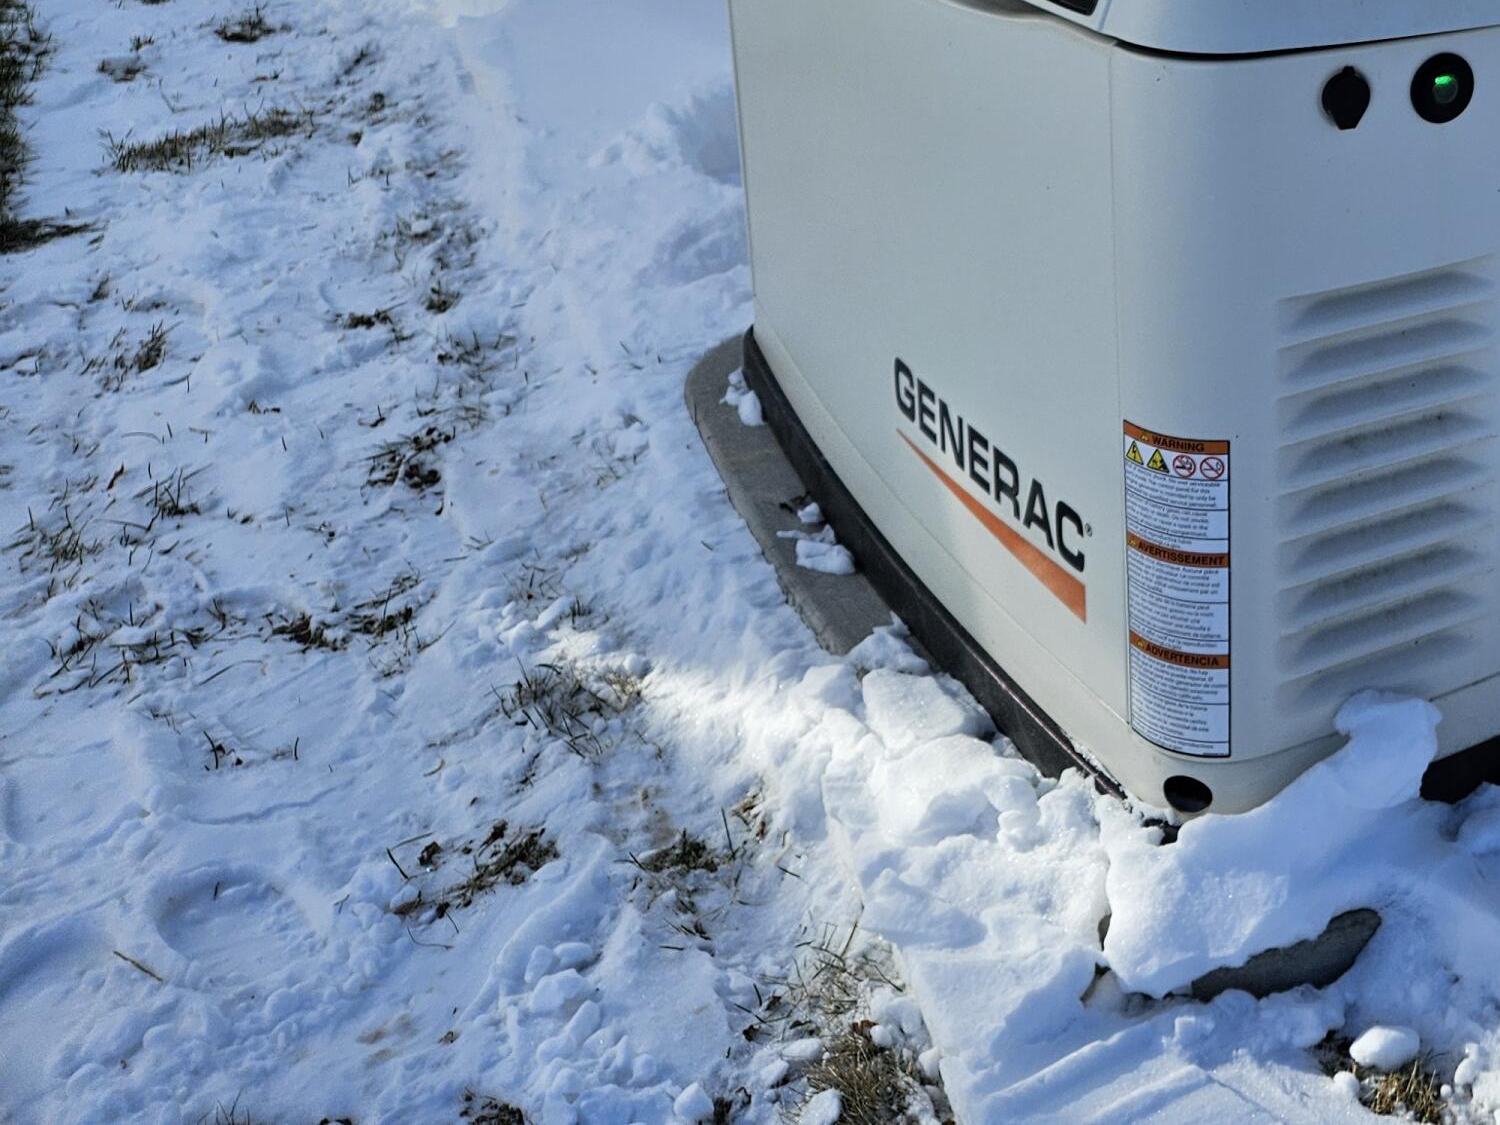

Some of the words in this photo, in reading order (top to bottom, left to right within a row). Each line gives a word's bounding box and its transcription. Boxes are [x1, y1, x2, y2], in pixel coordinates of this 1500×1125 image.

[1152, 435, 1205, 452] WARNING
[894, 356, 1085, 573] GENERAC
[1138, 541, 1225, 565] AVERTISSEMENT
[1145, 643, 1219, 666] ADVERTENCIA
